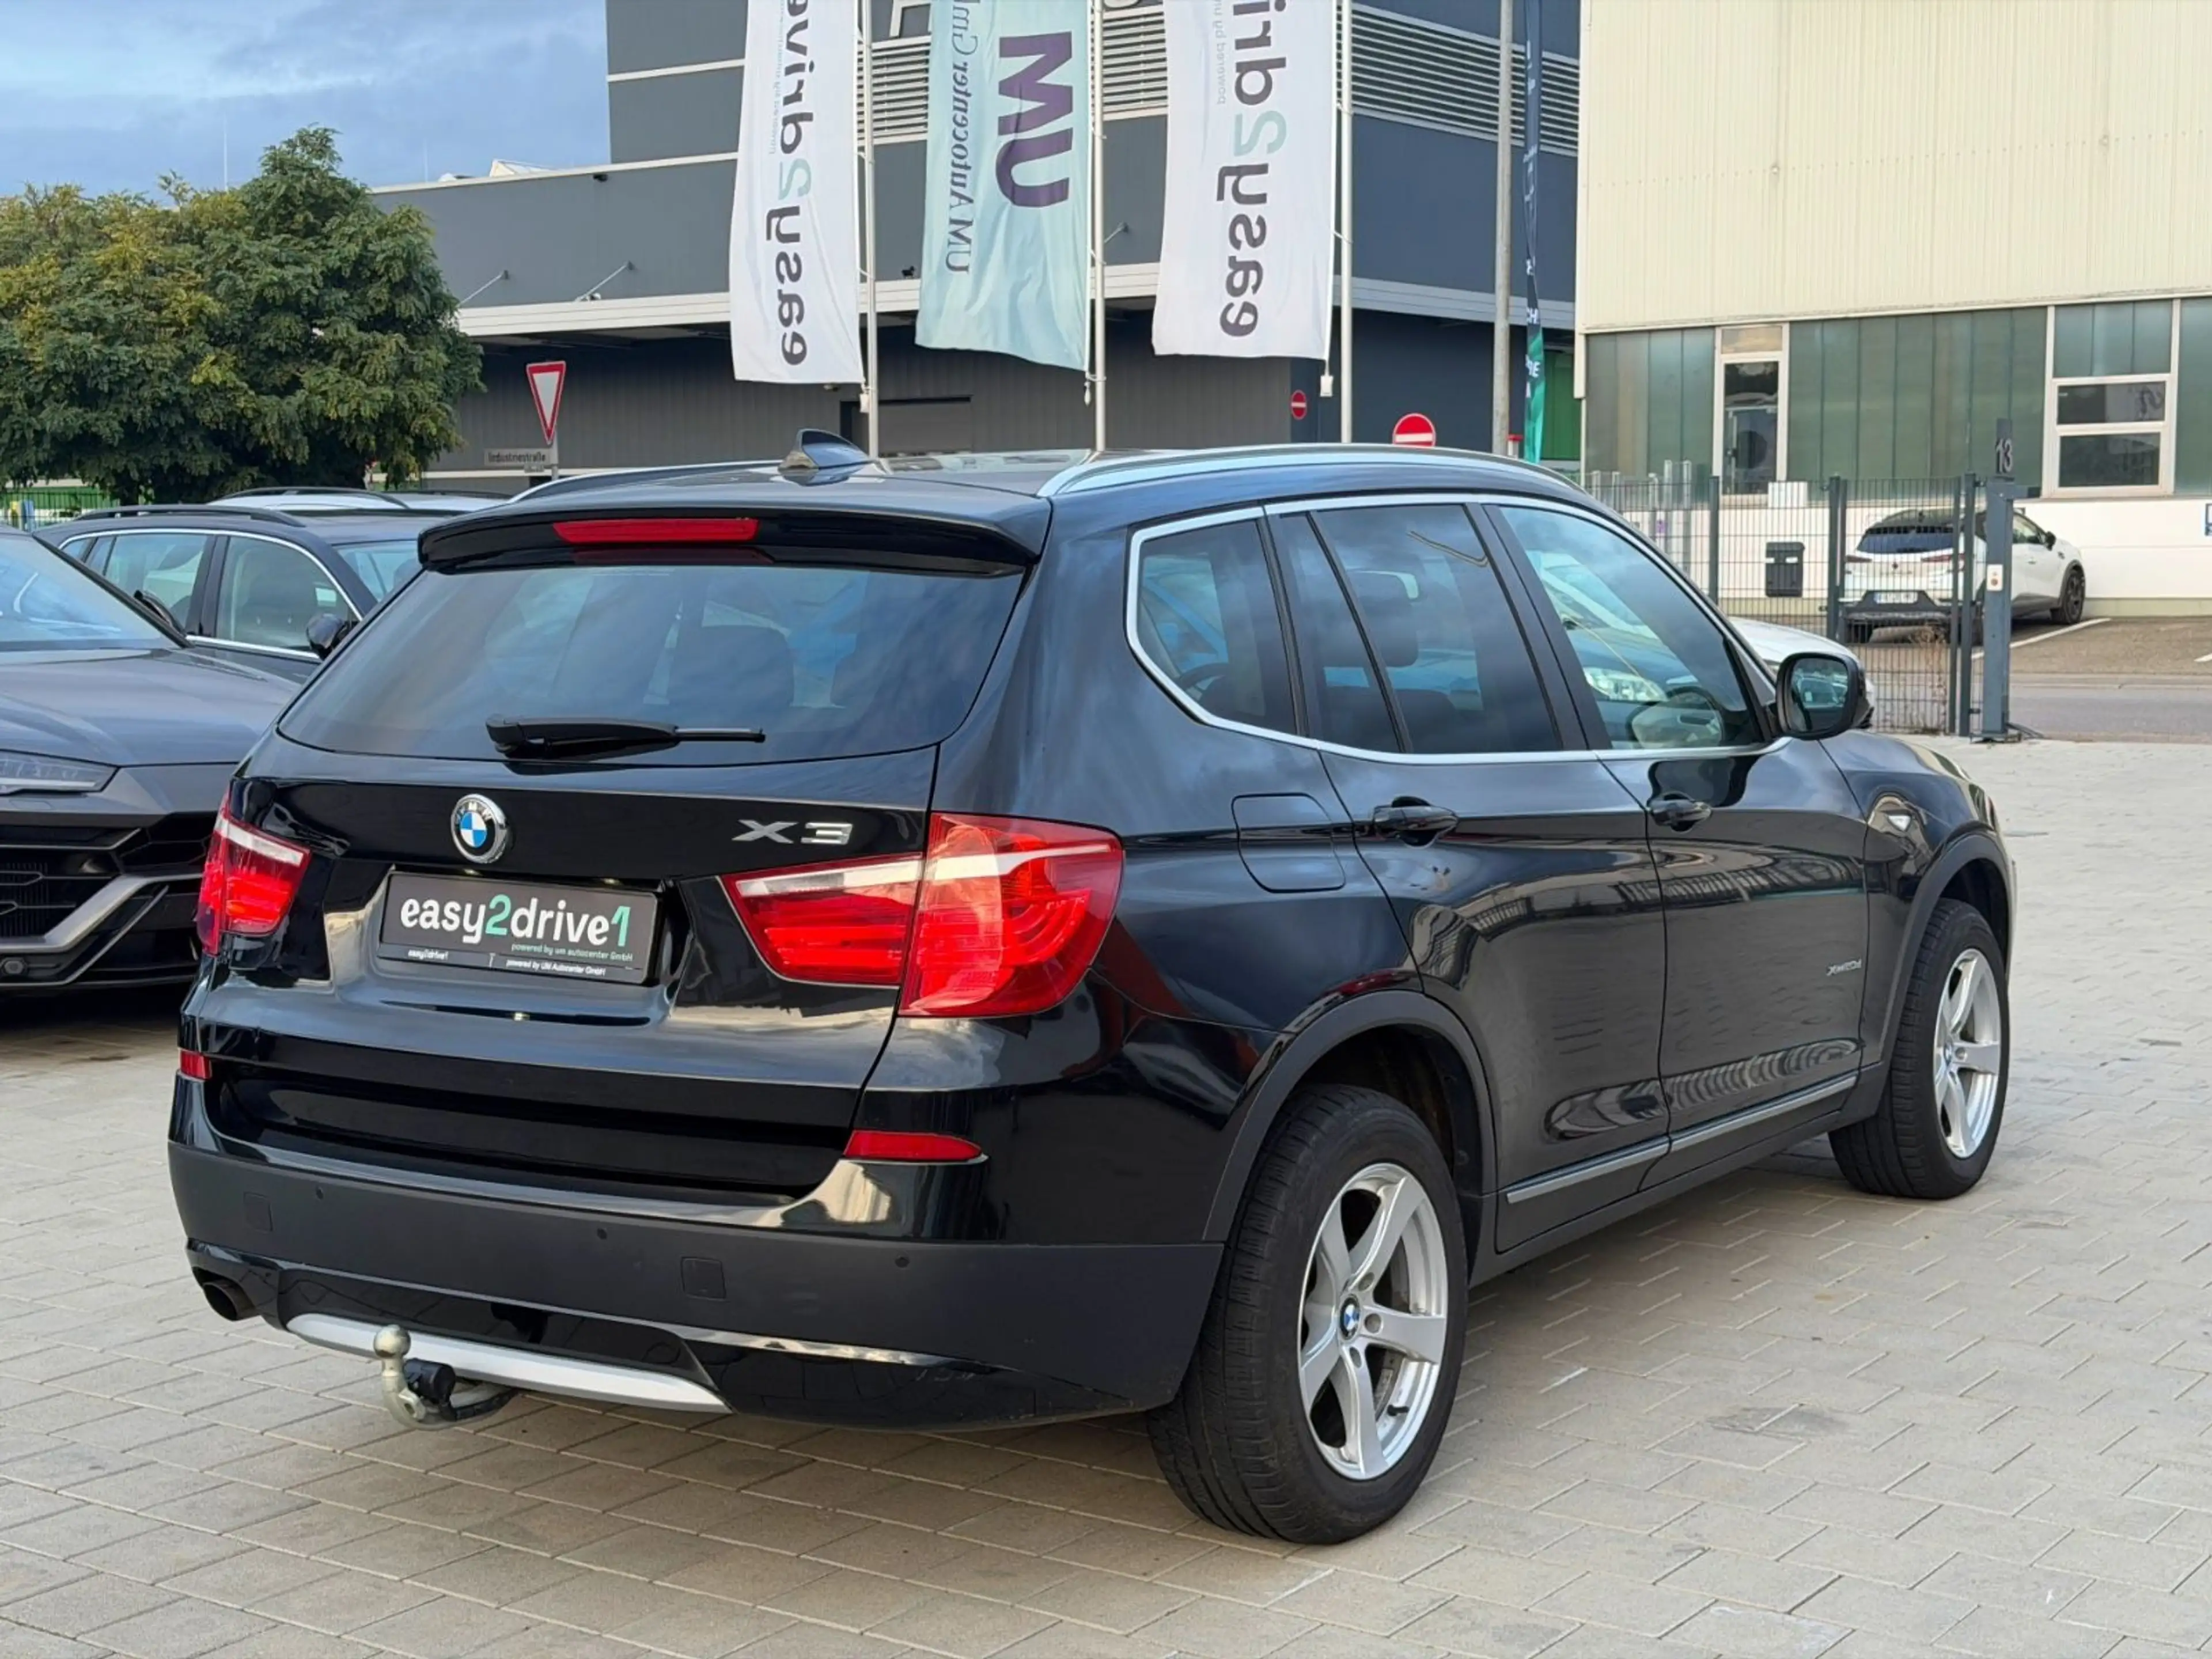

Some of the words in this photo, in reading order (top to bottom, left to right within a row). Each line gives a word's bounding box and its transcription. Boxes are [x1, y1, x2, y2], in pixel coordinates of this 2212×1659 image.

[1995, 438, 2013, 474] 13
[400, 894, 631, 947] easy2drive1
[512, 944, 542, 952] powered
[610, 952, 633, 961] GmbH
